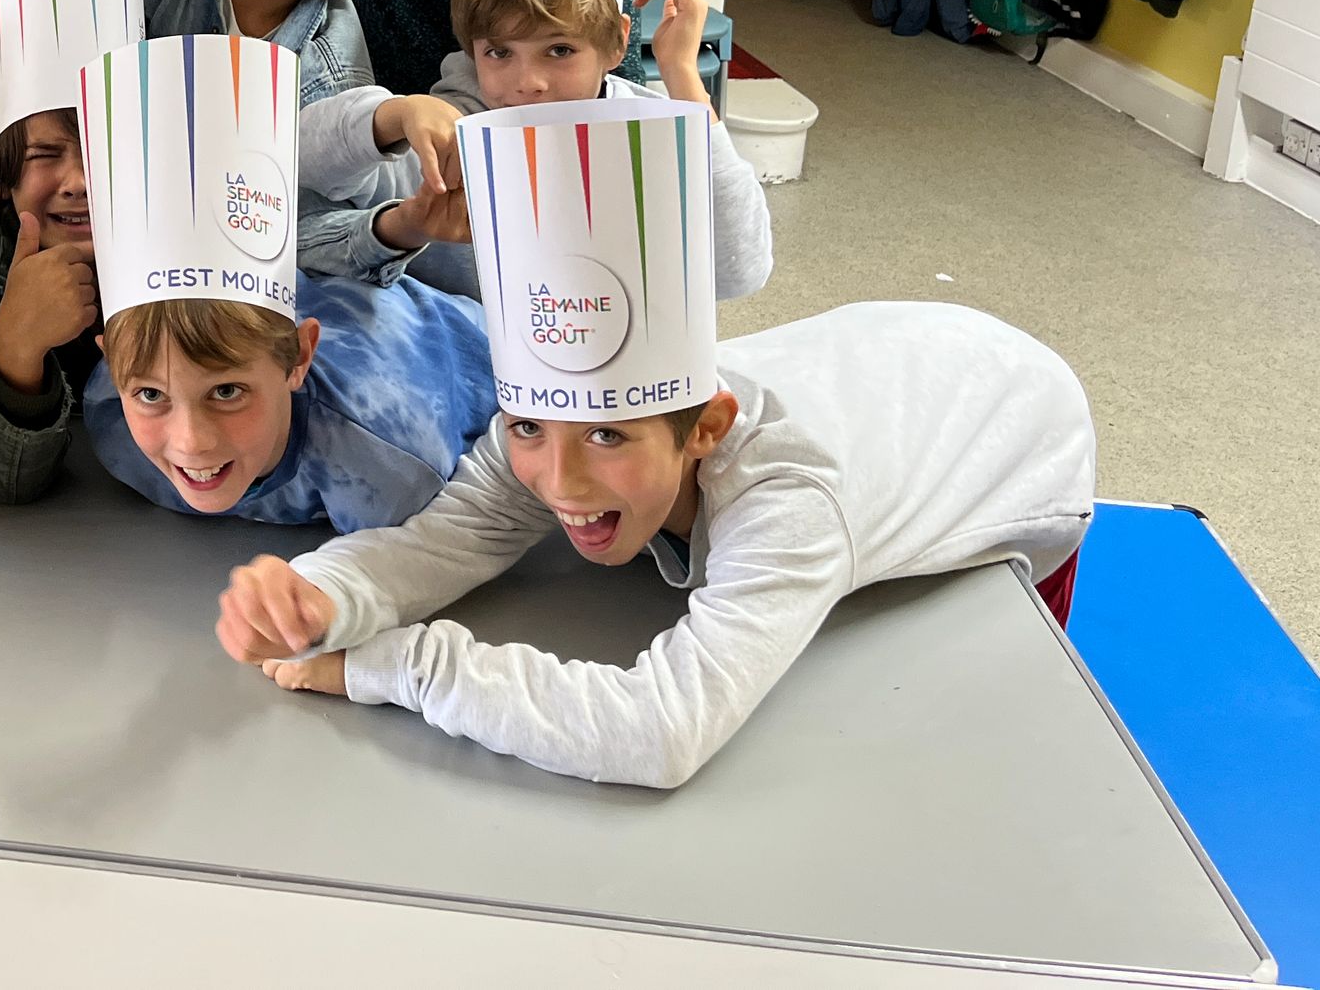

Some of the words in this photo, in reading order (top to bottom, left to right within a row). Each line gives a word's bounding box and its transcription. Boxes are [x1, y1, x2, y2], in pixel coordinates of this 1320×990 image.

[226, 172, 246, 186] LA
[227, 185, 282, 212] SEMAINE
[227, 200, 249, 215] DU
[228, 213, 270, 235] GOÛT
[147, 268, 214, 290] C'EST
[222, 270, 260, 294] MOI
[265, 278, 280, 301] LE
[282, 286, 295, 311] CH
[528, 283, 550, 296] LA
[530, 297, 612, 313] SEMAINE
[531, 314, 556, 327] DU
[533, 322, 590, 344] GOÛT
[495, 376, 523, 404] EST
[531, 388, 577, 409] MOI
[587, 389, 618, 409] LE
[626, 379, 680, 406] CHEF
